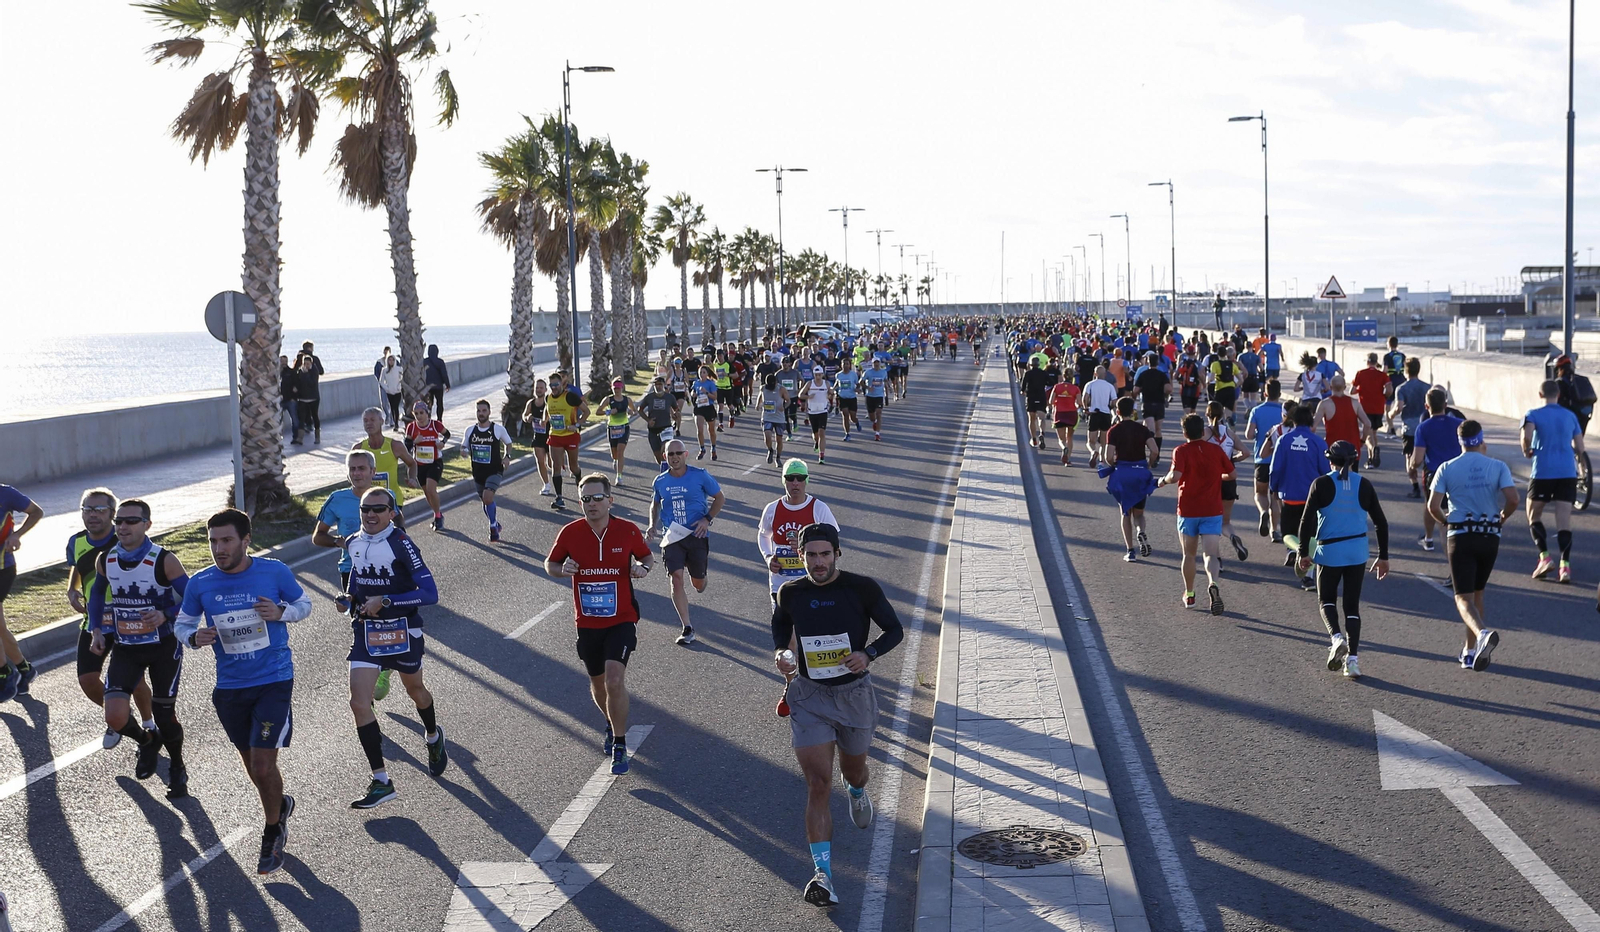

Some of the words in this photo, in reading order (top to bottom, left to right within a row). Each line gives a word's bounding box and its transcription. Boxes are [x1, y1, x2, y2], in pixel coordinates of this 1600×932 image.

[580, 568, 620, 576] DENMARK
[237, 613, 258, 621] ZURICH
[126, 622, 143, 631] 2062
[231, 626, 252, 637] 7806
[378, 632, 397, 641] 2063
[817, 651, 837, 661] 5710
